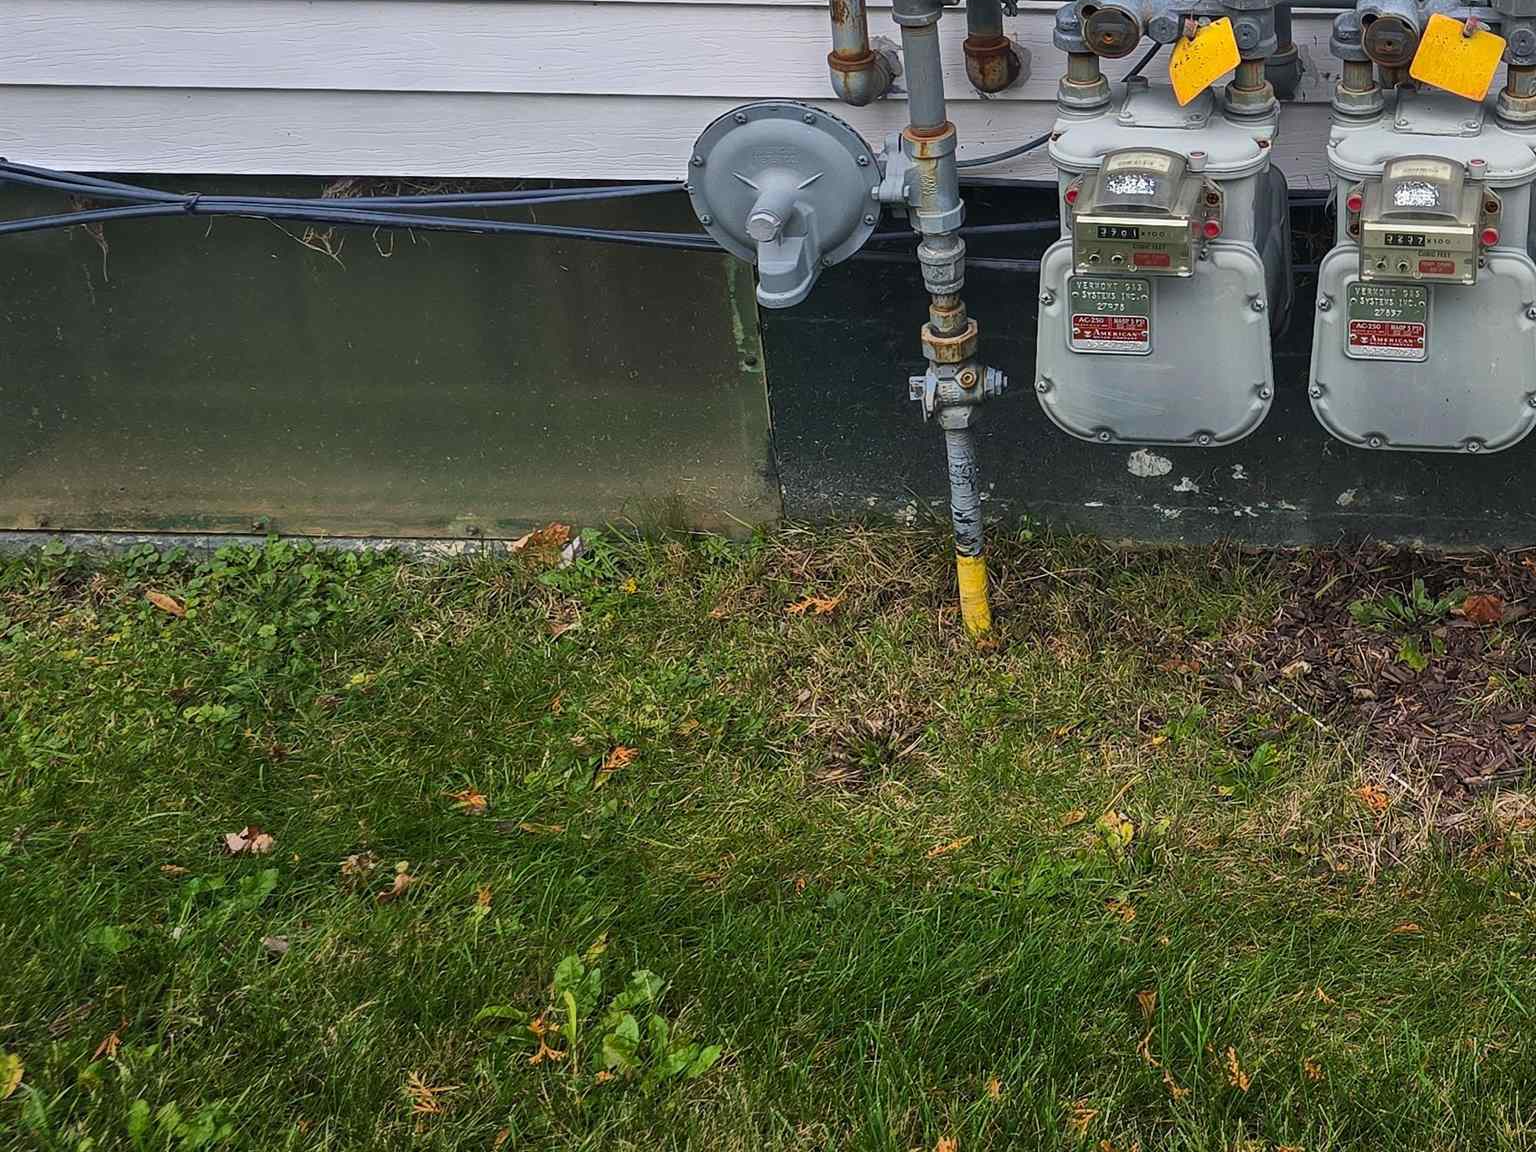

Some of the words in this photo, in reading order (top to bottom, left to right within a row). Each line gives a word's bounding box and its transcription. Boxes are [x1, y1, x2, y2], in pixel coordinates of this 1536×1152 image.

[1076, 281, 1119, 289] VERMONT
[1125, 283, 1142, 291] GAS
[1082, 291, 1116, 300] SYSTEMS
[1355, 288, 1396, 296] VERMONT
[1403, 290, 1420, 298] GAS
[1360, 297, 1394, 306] SYSTEMS
